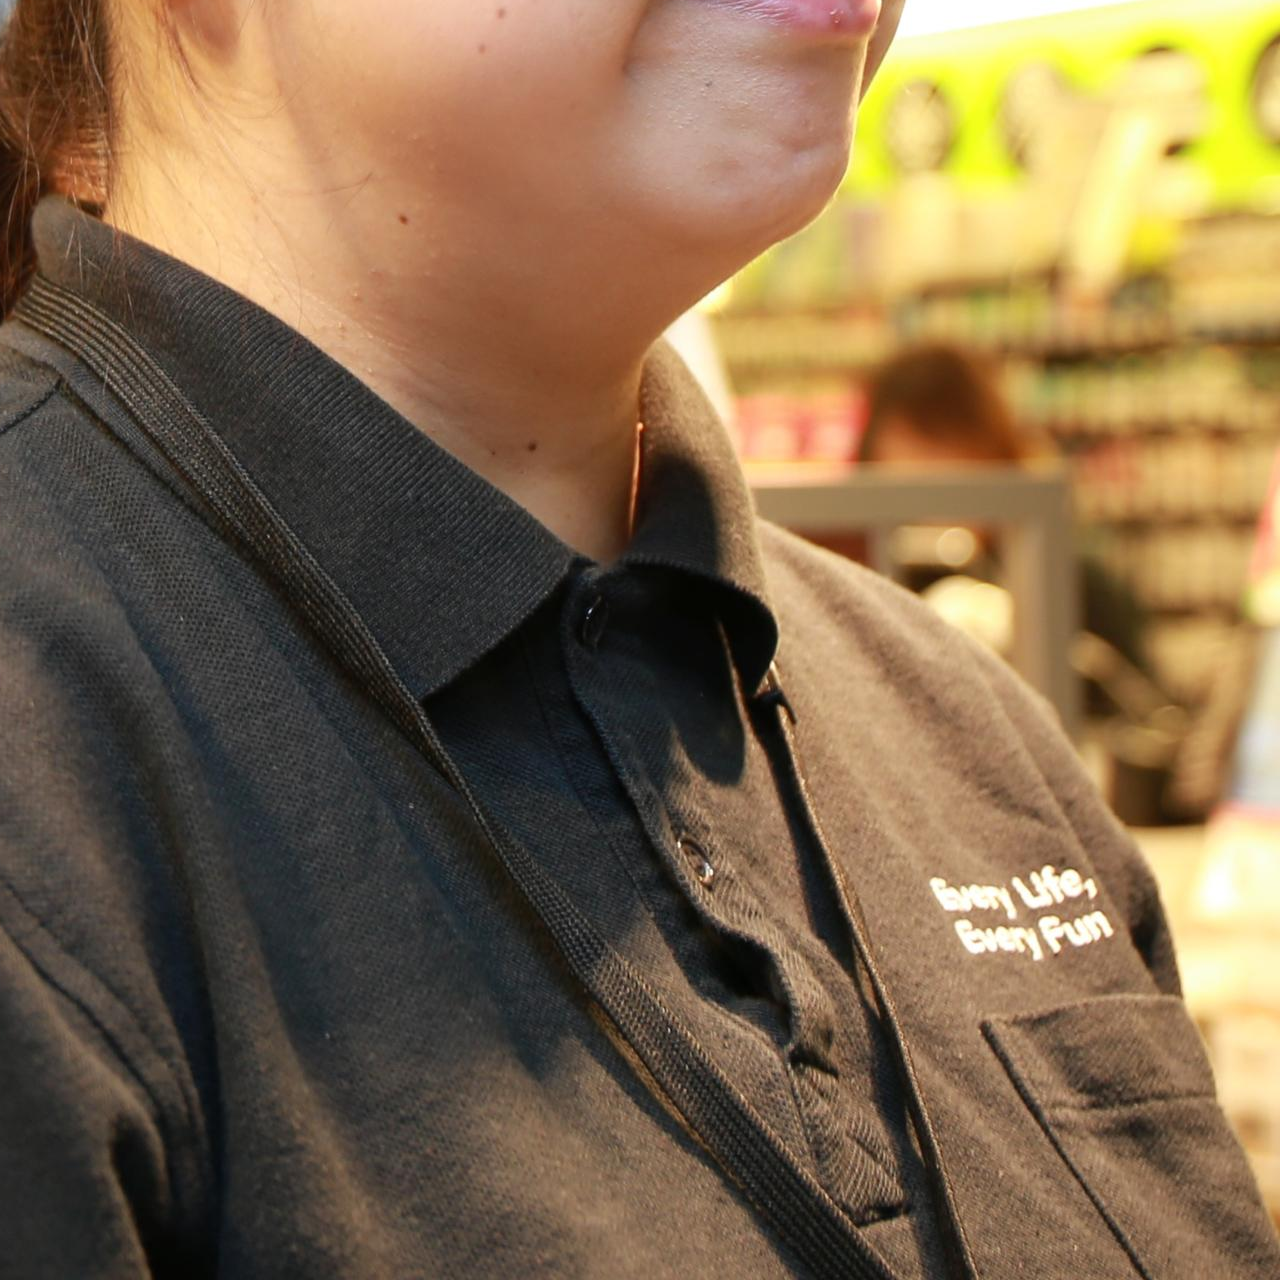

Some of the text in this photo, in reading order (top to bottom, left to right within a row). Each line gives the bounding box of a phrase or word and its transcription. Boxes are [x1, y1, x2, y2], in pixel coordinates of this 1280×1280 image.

[929, 865, 1097, 920] Every Life,
[955, 911, 1114, 961] Every Fun
